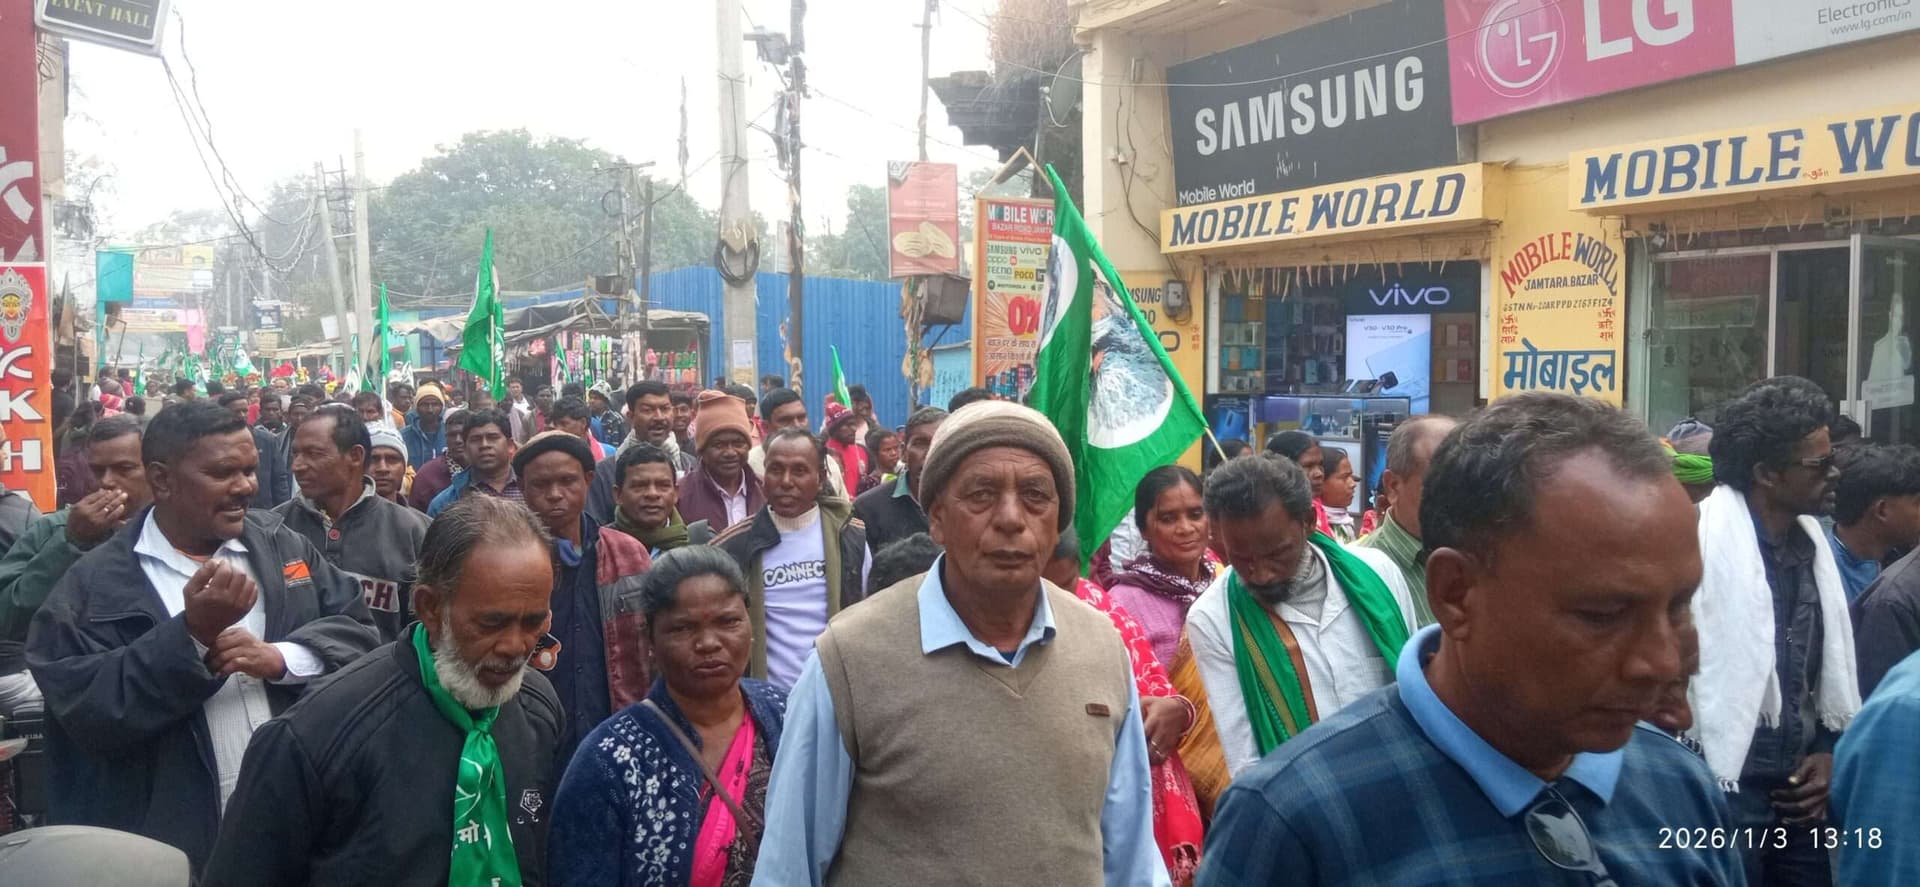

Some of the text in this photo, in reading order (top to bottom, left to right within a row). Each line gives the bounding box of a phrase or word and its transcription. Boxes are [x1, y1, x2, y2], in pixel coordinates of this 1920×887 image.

[1583, 0, 1695, 62] LG
[1830, 10, 1912, 35] www.lg.com/in
[1195, 56, 1424, 156] SAMSUNG
[1179, 179, 1256, 205] Mobile World
[1580, 128, 1804, 204] MOBILE
[1169, 172, 1466, 247] MOBILE WORLD
[1369, 283, 1450, 306] vivo
[1501, 231, 1572, 298] MOBILE
[1503, 337, 1616, 395] मोबाइल
